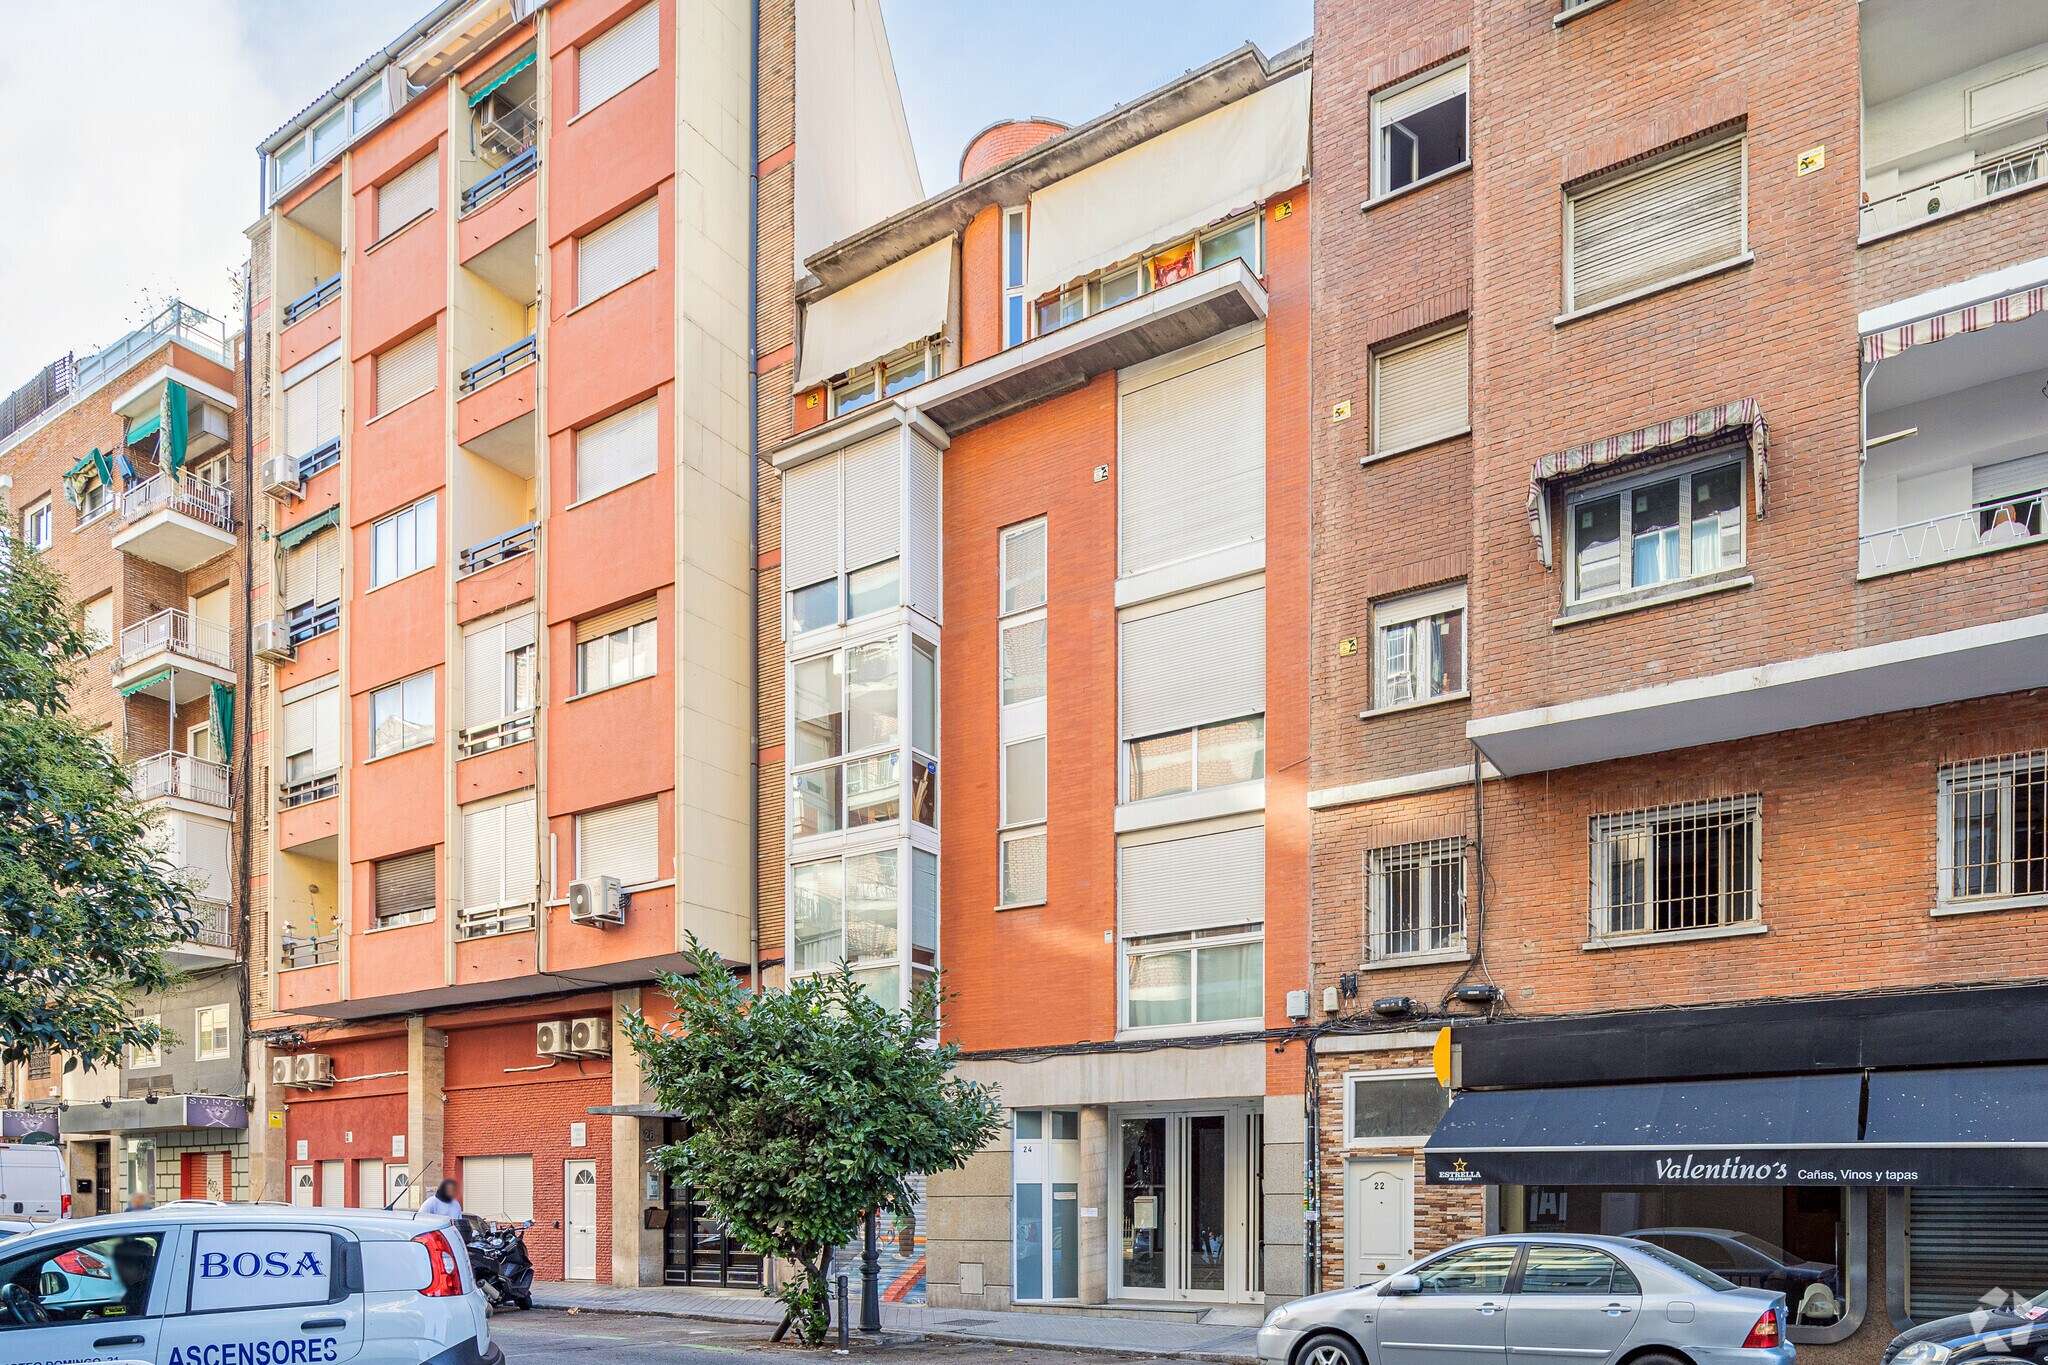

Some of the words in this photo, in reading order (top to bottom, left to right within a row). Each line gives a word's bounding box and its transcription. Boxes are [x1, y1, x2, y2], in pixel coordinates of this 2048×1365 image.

[644, 1130, 655, 1140] 26
[1798, 1169, 1837, 1181] Cañas,
[1840, 1169, 1873, 1180] Vinos
[1876, 1172, 1883, 1182] y
[1885, 1170, 1918, 1182] tapas
[1374, 1181, 1385, 1190] 22
[200, 1251, 327, 1279] BOSA
[168, 1337, 338, 1365] ASCENSORES
